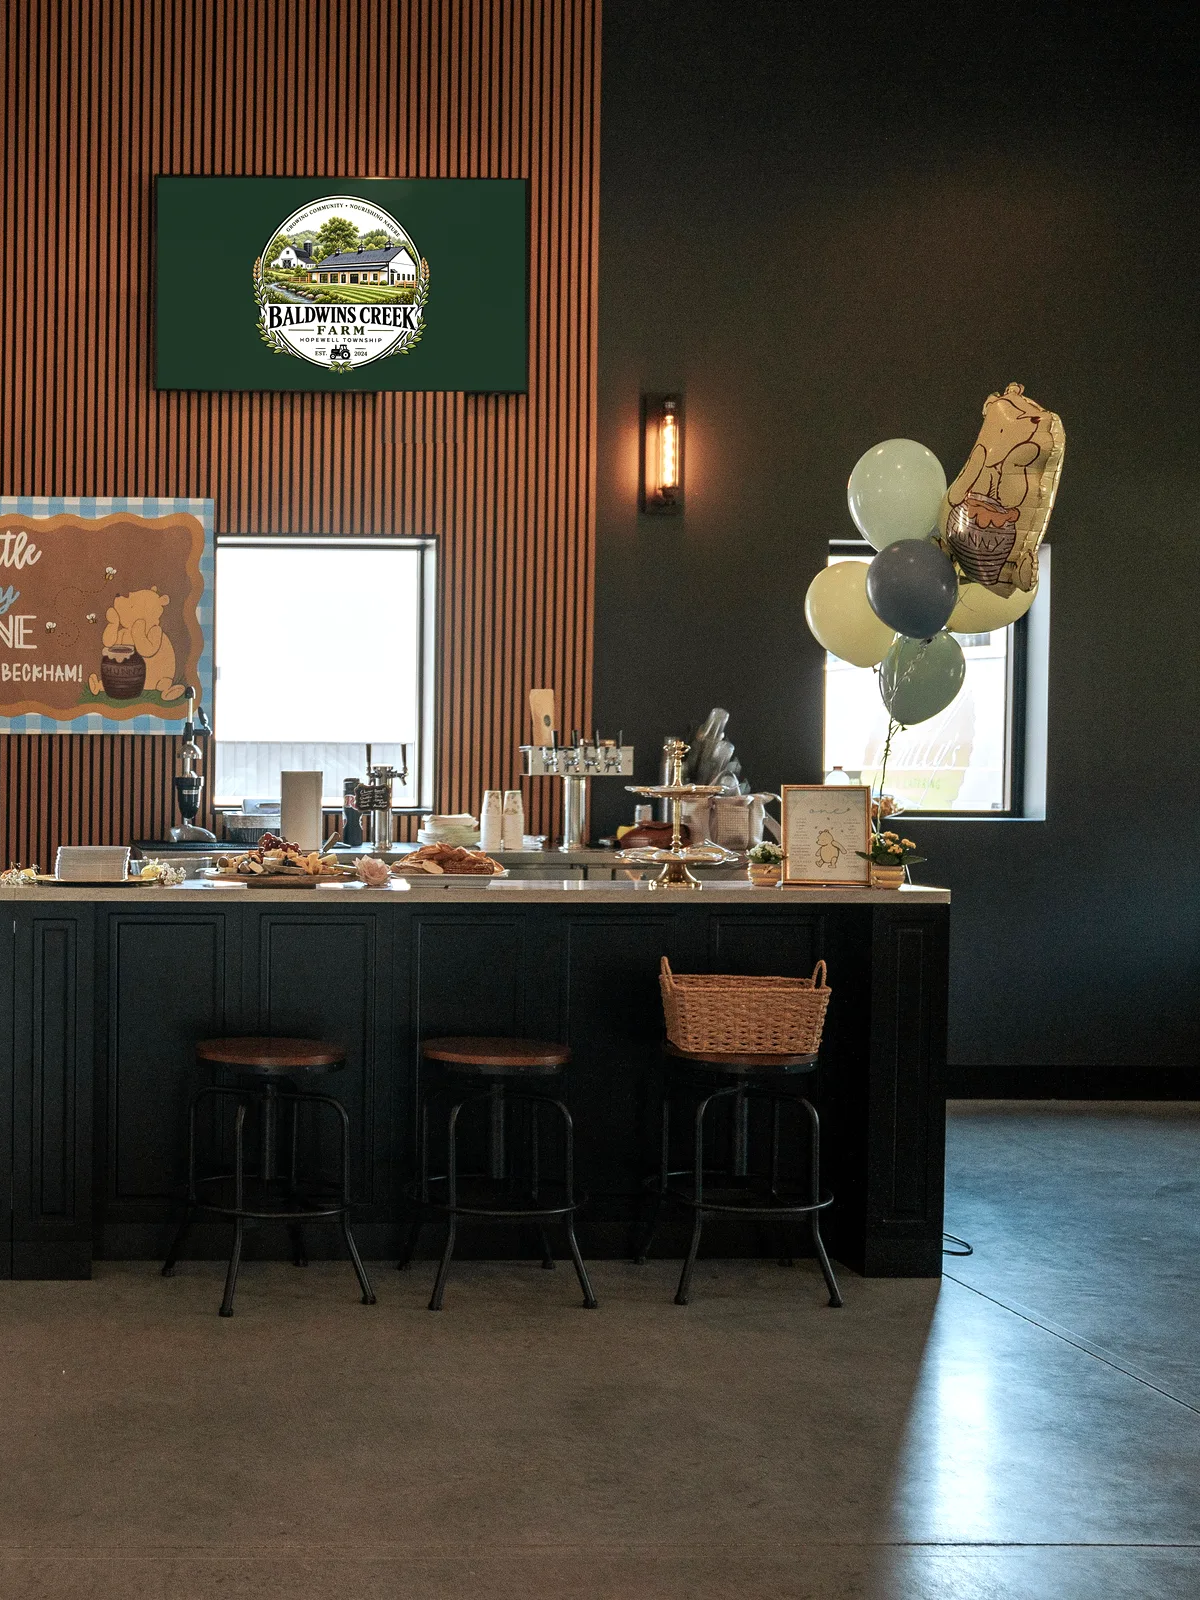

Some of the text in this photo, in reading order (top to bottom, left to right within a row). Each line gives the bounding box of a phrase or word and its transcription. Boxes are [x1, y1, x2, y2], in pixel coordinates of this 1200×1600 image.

[286, 203, 401, 238] GROWING COMMUNITY NOURISHING NATURE
[268, 305, 417, 331] BALDWINS CREEK
[316, 325, 365, 335] FARM
[951, 522, 1005, 553] HUNNY
[1, 663, 83, 682] BECKHAM!
